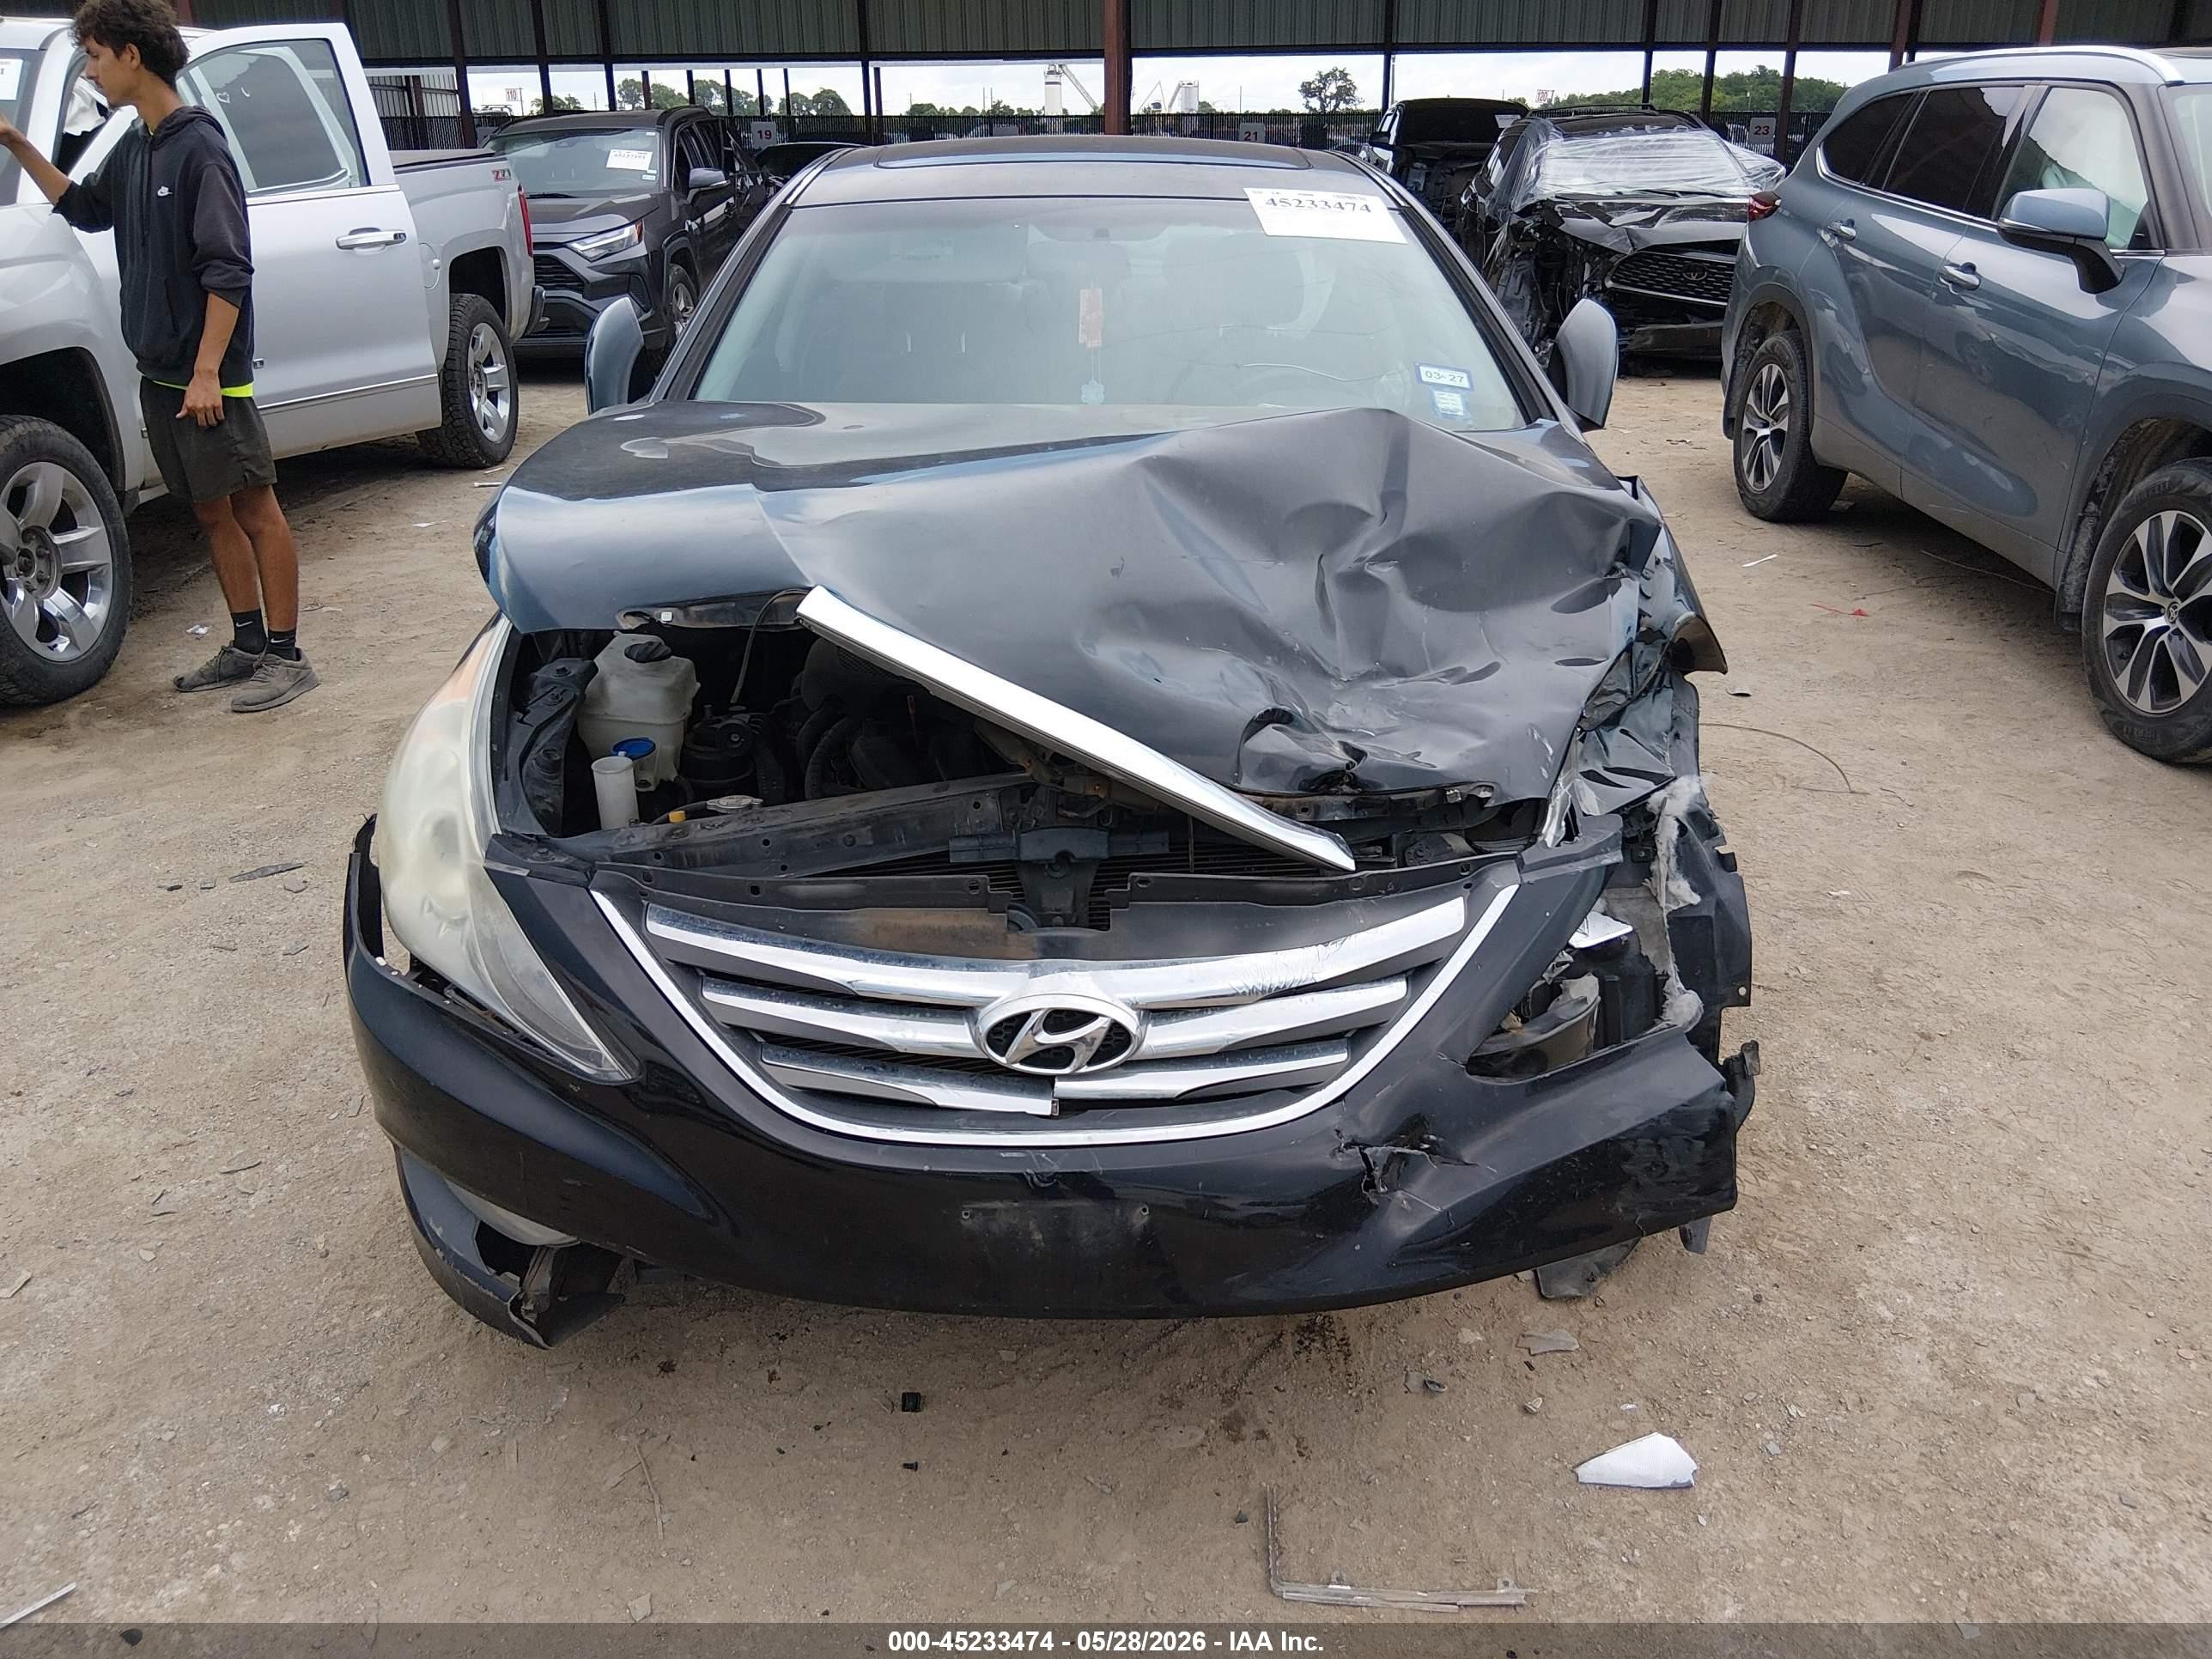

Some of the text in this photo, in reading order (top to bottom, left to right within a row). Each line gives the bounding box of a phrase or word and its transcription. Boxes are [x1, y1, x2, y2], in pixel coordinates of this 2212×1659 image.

[757, 130, 772, 140] 19
[1753, 125, 1770, 135] 23
[1243, 131, 1258, 142] 21
[1266, 198, 1372, 213] 45233474
